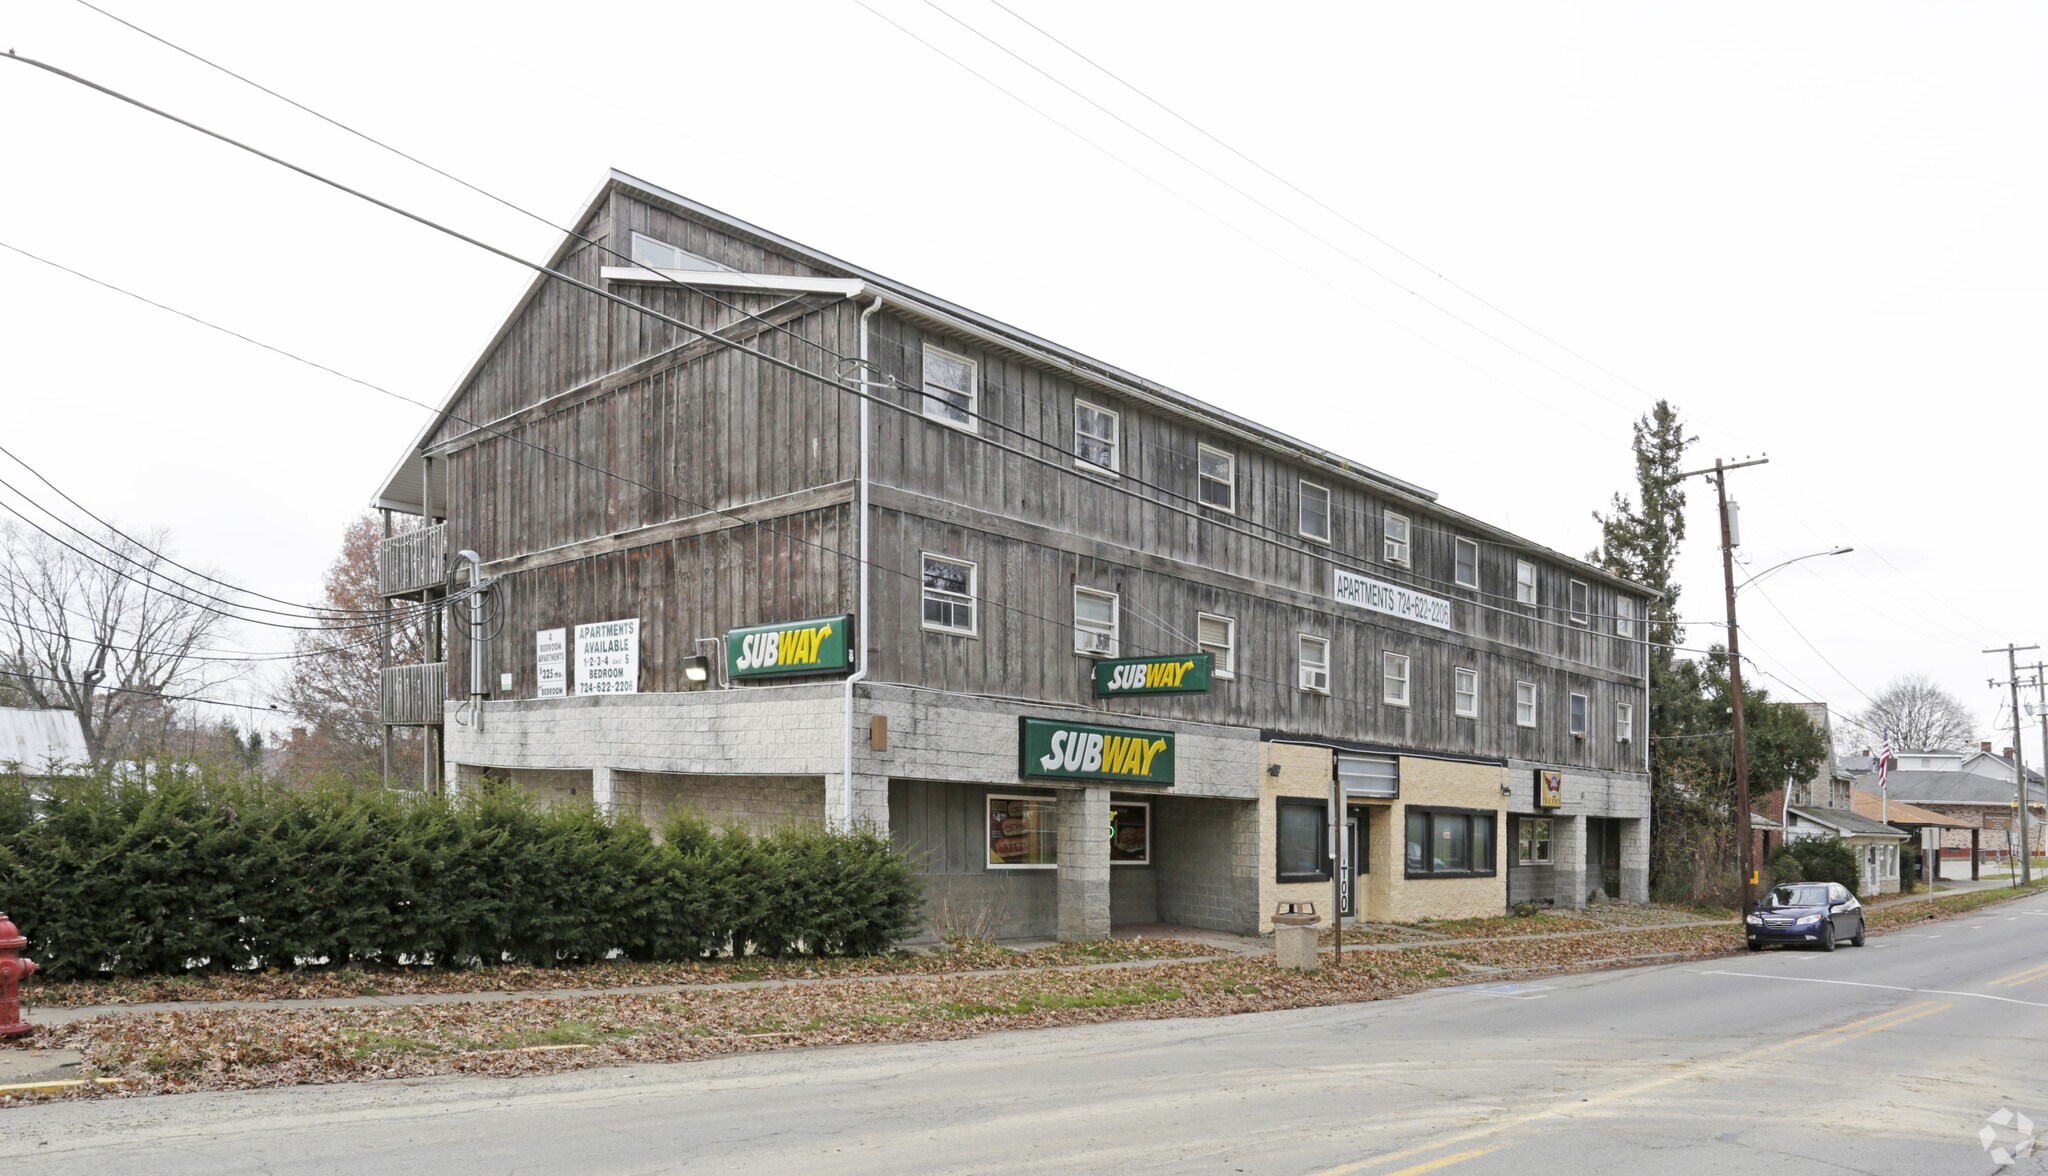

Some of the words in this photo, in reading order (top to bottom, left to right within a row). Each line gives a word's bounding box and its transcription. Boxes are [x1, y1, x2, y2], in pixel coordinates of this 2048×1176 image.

[1337, 575, 1394, 611] APARTMENTS
[1397, 591, 1449, 625] 724-622-2206
[579, 622, 634, 639] APARTMENTS
[540, 642, 562, 652] BEDROOM
[584, 638, 629, 654] AVAILABLE
[736, 622, 832, 672] SUBWAY
[538, 652, 564, 662] APARTMENTS
[583, 656, 609, 667] 1-2-3-4
[625, 654, 630, 664] 5
[589, 668, 624, 679] BEDROOM
[1107, 659, 1194, 691] SUBWAY
[541, 687, 563, 696] BEDROOM
[580, 681, 633, 693] 724-622-2206
[1040, 730, 1167, 776] SUBWAY
